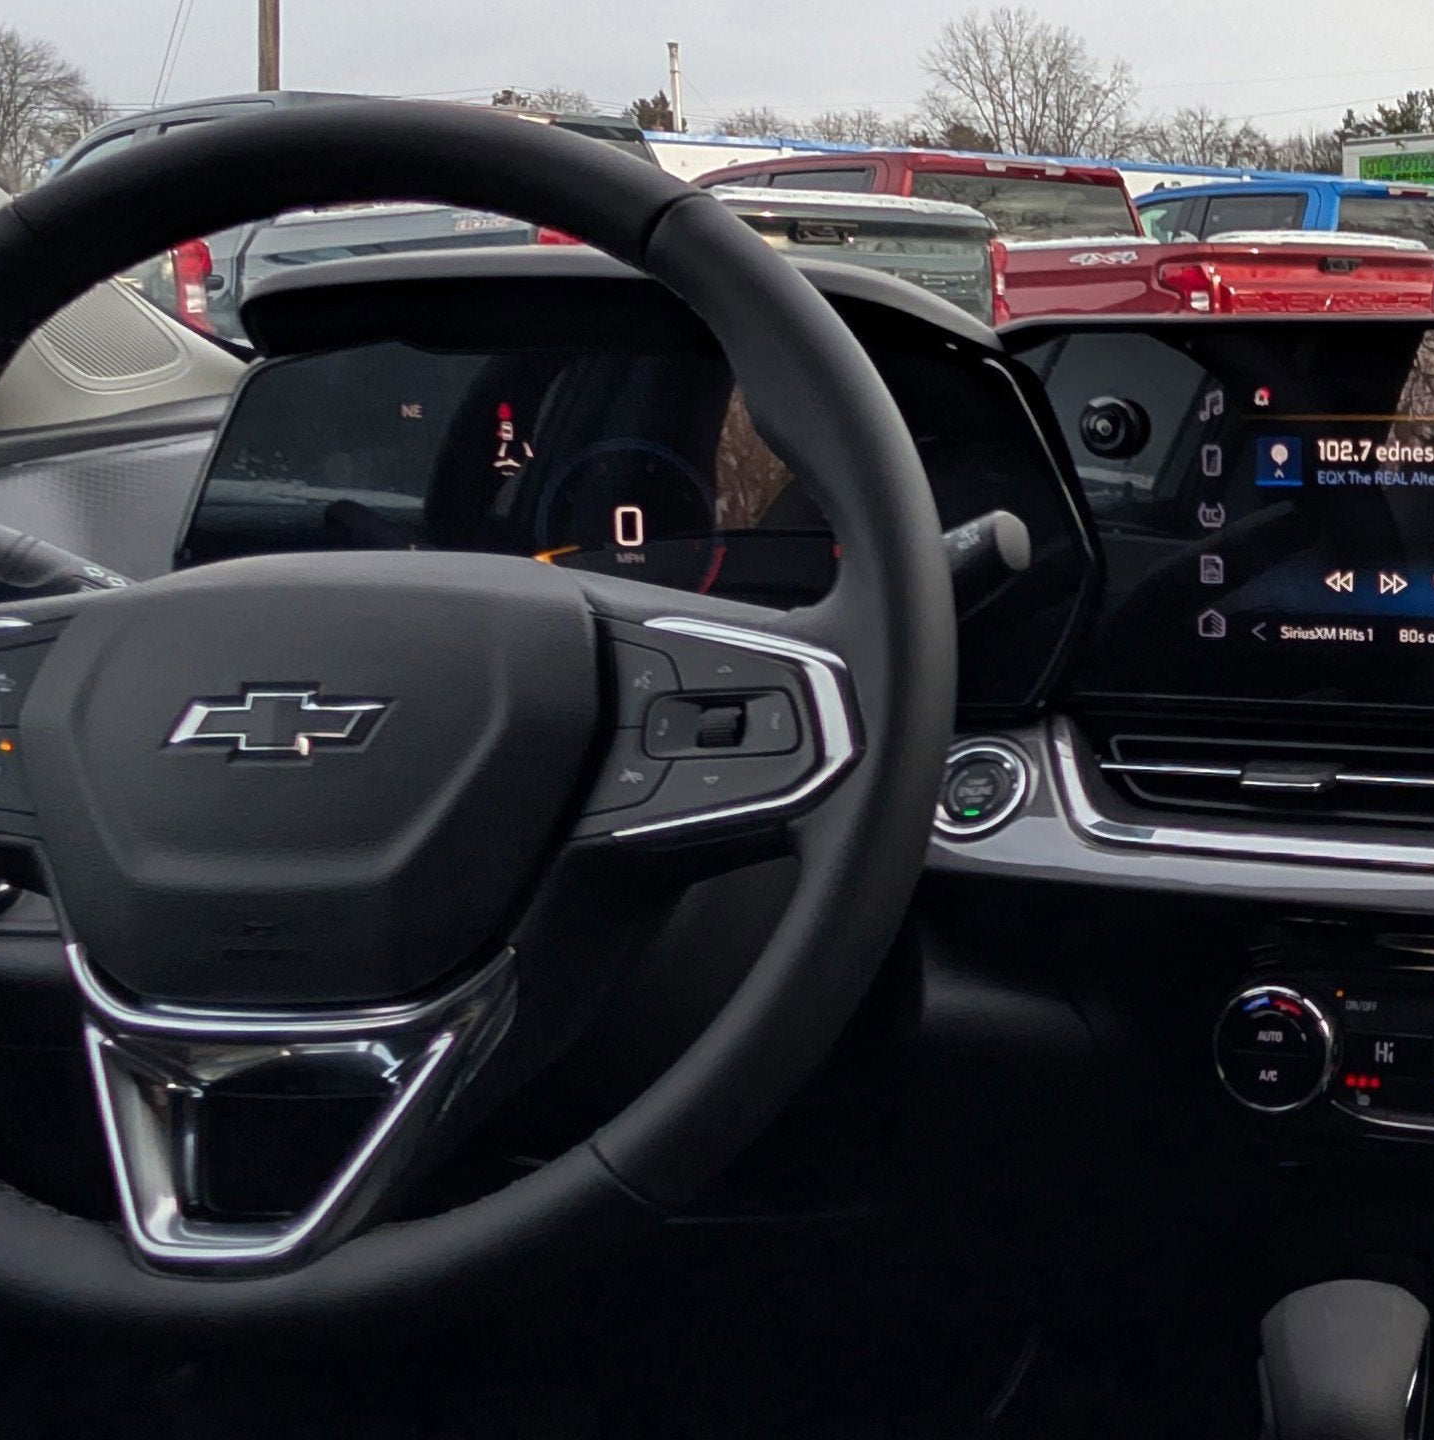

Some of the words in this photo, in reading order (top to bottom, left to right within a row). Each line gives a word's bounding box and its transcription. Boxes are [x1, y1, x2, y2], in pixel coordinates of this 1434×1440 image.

[401, 403, 423, 419] NE
[1317, 440, 1372, 462] 102.7
[1317, 470, 1345, 486] EQX
[1348, 469, 1372, 485] The
[1375, 471, 1408, 486] REAL
[614, 505, 644, 547] 0
[1280, 626, 1337, 640] SiriusXM
[1339, 627, 1365, 641] Hits
[1367, 628, 1374, 642] 1
[1399, 629, 1425, 644] 80s
[1256, 1030, 1283, 1043] AUTO
[1258, 1069, 1279, 1082] A/C
